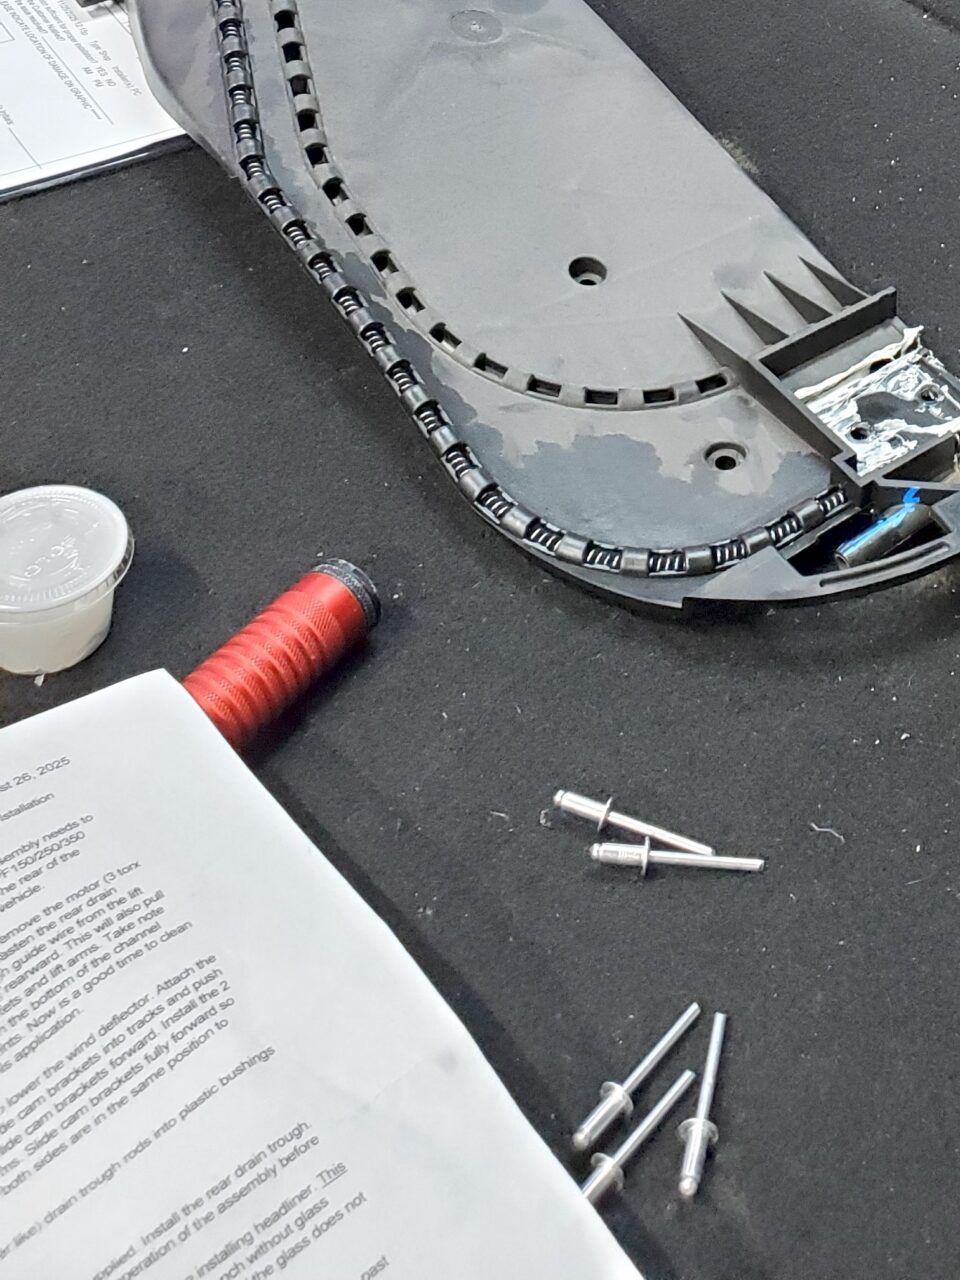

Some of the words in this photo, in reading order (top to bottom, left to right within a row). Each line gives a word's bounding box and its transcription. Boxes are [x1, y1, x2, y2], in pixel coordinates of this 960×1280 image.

[82, 66, 92, 74] AM
[94, 66, 108, 76] YES
[12, 772, 37, 787] 26,
[36, 756, 71, 776] 2025
[18, 867, 43, 885] rear
[46, 857, 59, 870] of
[59, 848, 81, 863] the
[42, 821, 80, 842] needs
[80, 814, 94, 824] to
[11, 942, 47, 971] guide
[48, 926, 75, 945] wire
[76, 909, 106, 928] from
[106, 896, 128, 911] the
[128, 886, 144, 900] lift
[36, 922, 57, 937] the
[59, 905, 83, 923] rear
[86, 886, 118, 907] drain
[42, 901, 64, 917] the
[65, 880, 100, 904] motor
[102, 871, 117, 884] (3
[116, 860, 142, 876] torx
[4, 950, 63, 992] rearward.
[63, 931, 93, 951] This
[93, 917, 114, 933] will
[115, 904, 142, 921] also
[143, 889, 166, 909] pull
[7, 1009, 30, 1028] the
[30, 976, 75, 1011] bottom
[76, 964, 90, 979] of
[90, 951, 112, 968] the
[113, 921, 162, 954] channel
[24, 974, 49, 998] and
[50, 964, 65, 978] lift
[66, 943, 102, 968] arms.
[102, 922, 136, 943] Take
[137, 905, 166, 924] note
[26, 1006, 57, 1032] Now
[58, 998, 71, 1009] is
[72, 989, 82, 1000] a
[83, 964, 116, 994] good
[115, 949, 145, 970] time
[144, 939, 159, 951] to
[159, 920, 193, 944] clean
[5, 1075, 42, 1108] lower
[42, 1060, 65, 1080] the
[65, 1032, 97, 1062] wind
[98, 993, 154, 1037] deflector.
[155, 965, 196, 996] Attach
[195, 954, 217, 970] the
[14, 1007, 84, 1063] application.
[17, 1095, 47, 1121] cam
[46, 1052, 102, 1098] brackets
[102, 1032, 126, 1055] into
[126, 1004, 166, 1036] tracks
[167, 984, 192, 1007] and
[192, 966, 224, 993] push
[24, 1110, 54, 1137] cam
[54, 1066, 110, 1113] brackets
[108, 1028, 160, 1070] forward.
[161, 999, 200, 1031] Install
[198, 987, 220, 1004] the
[220, 979, 231, 992] 2
[24, 1127, 59, 1157] Slide
[60, 1104, 89, 1131] cam
[89, 1062, 145, 1108] brackets
[143, 1040, 171, 1065] fully
[170, 1004, 218, 1045] forward
[219, 996, 236, 1011] so
[33, 1141, 69, 1172] sides
[69, 1123, 92, 1145] are
[93, 1111, 108, 1127] in
[106, 1094, 130, 1115] the
[129, 1065, 166, 1098] same
[166, 1026, 215, 1071] position
[215, 1018, 229, 1031] to
[43, 1193, 79, 1225] drain
[78, 1160, 122, 1198] trough
[122, 1136, 153, 1165] rods
[153, 1116, 178, 1140] into
[178, 1081, 220, 1121] plastic
[218, 1044, 276, 1088] bushings
[140, 1211, 181, 1247] Install
[180, 1196, 205, 1217] the
[205, 1174, 233, 1200] rear
[234, 1147, 268, 1179] drain
[267, 1119, 313, 1154] trough.
[177, 1222, 193, 1243] of
[191, 1210, 216, 1232] the
[216, 1164, 279, 1215] assembly
[278, 1133, 321, 1169] before
[196, 1231, 255, 1279] installing
[253, 1183, 318, 1235] headliner.
[315, 1160, 349, 1188] This
[245, 1223, 295, 1264] without
[294, 1195, 329, 1231] glass
[275, 1235, 312, 1271] glass
[311, 1209, 345, 1240] does
[344, 1190, 368, 1215] not
